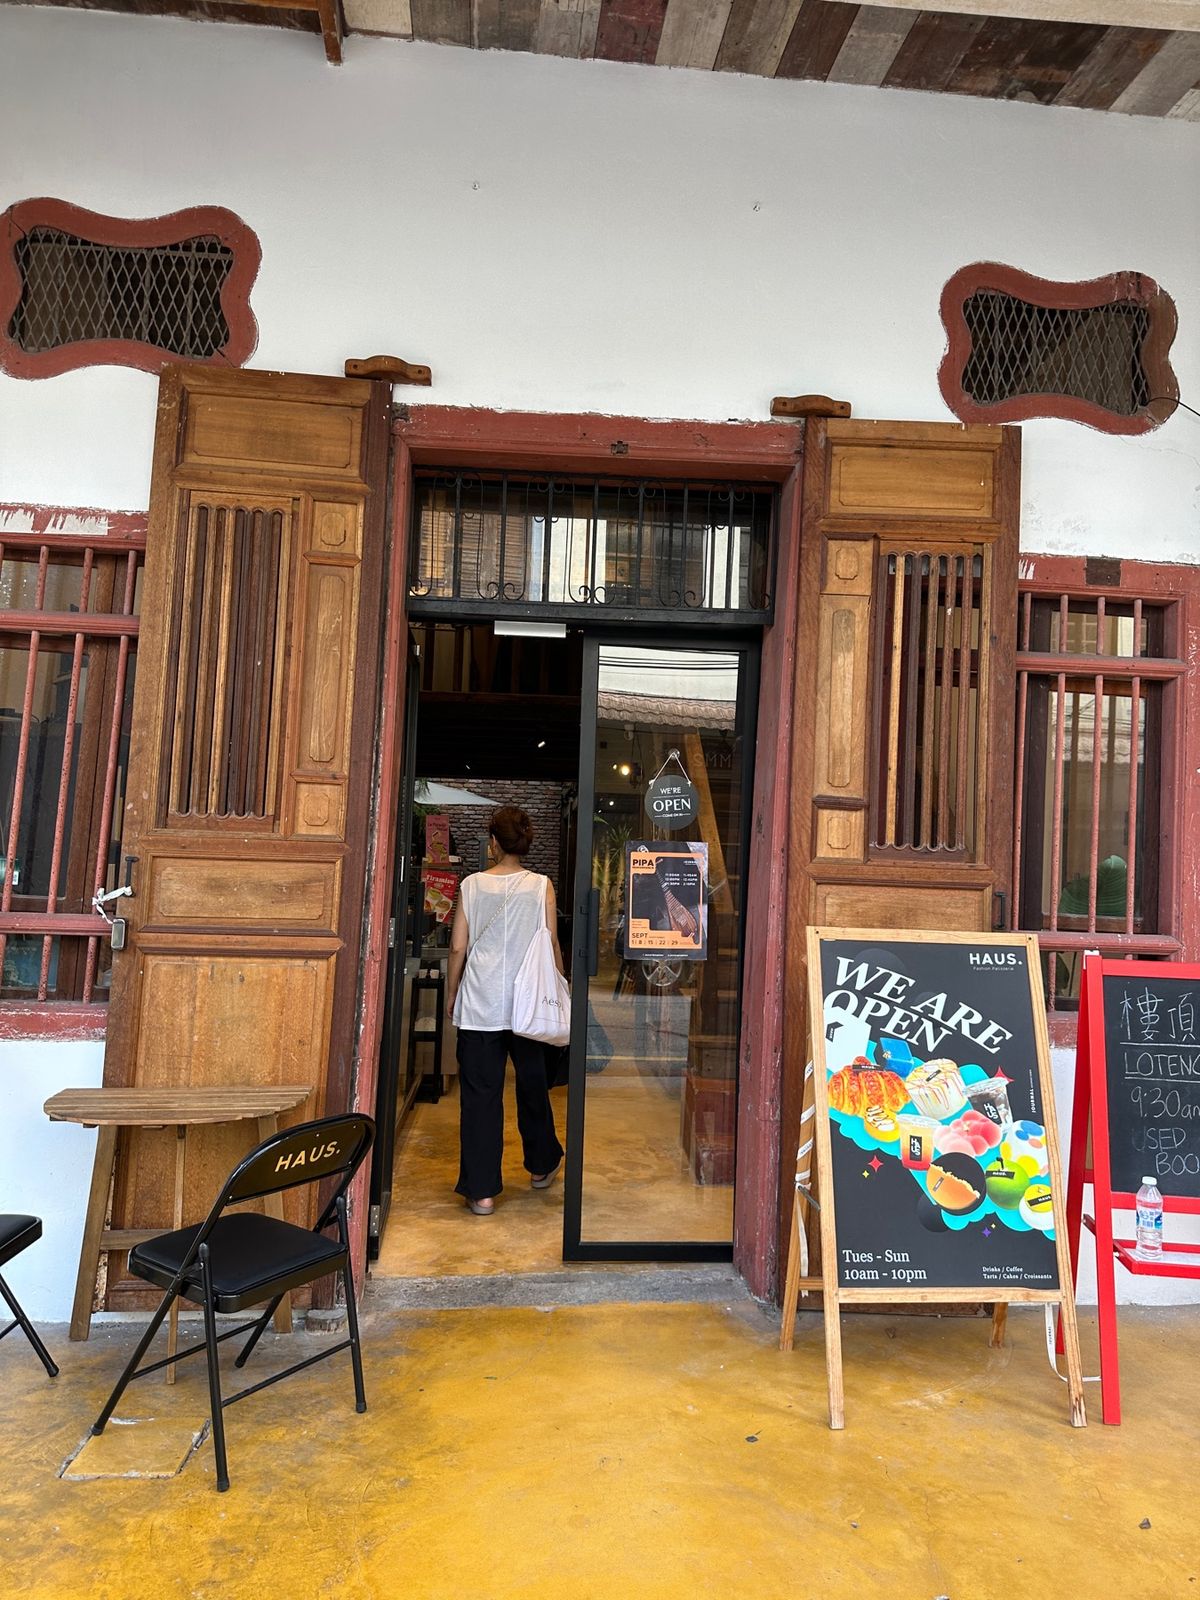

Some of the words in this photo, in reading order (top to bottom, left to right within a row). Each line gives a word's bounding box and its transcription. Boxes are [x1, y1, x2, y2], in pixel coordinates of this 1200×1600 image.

[653, 798, 691, 812] OPEN
[969, 952, 1023, 965] HAUS.
[542, 996, 563, 1011] Aes
[836, 956, 916, 1004] WE
[910, 992, 1014, 1054] ARE
[823, 989, 953, 1052] OPEN
[1132, 1126, 1186, 1151] USED
[274, 1141, 340, 1172] HAUS.
[842, 1250, 874, 1262] Tues
[885, 1249, 910, 1262] Sun
[844, 1269, 879, 1280] 10am
[891, 1269, 927, 1283] 10pm
